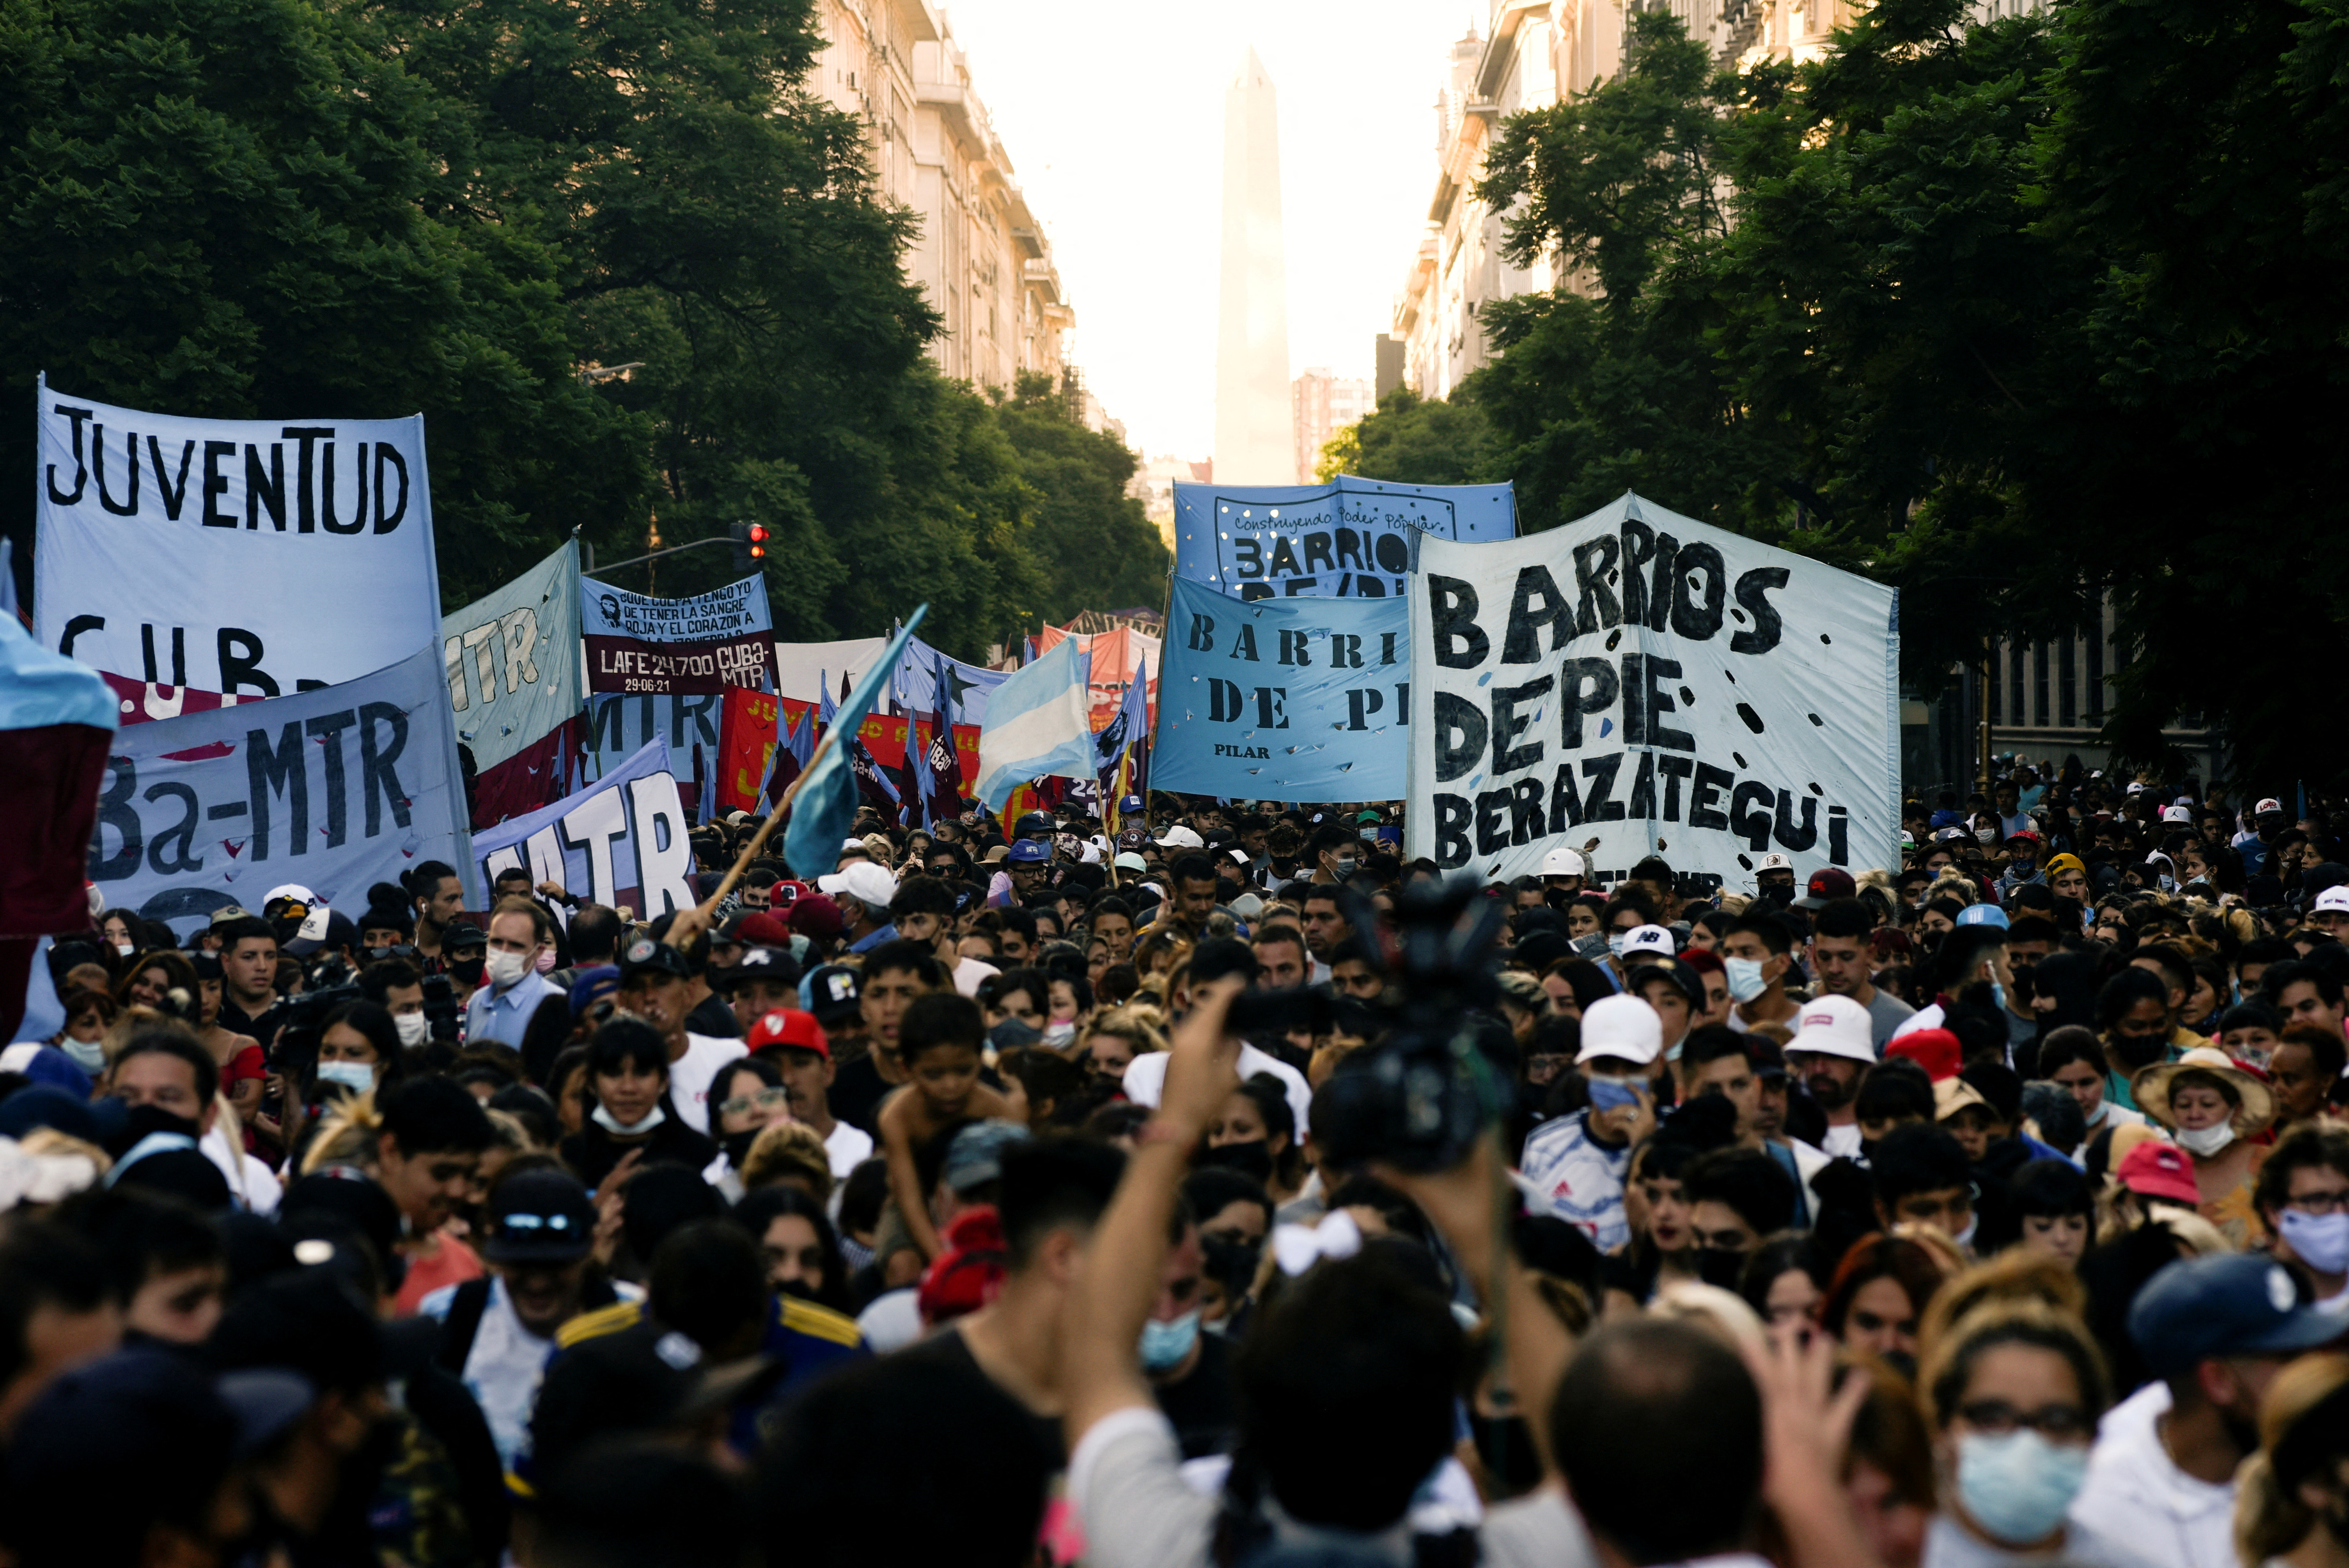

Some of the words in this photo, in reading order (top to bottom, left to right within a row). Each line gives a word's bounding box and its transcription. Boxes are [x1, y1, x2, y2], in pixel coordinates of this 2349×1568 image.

[47, 404, 408, 535] JUVENTUD
[1235, 513, 1331, 534] Construyendo
[1339, 507, 1378, 524] Poder
[736, 581, 750, 596] YO
[1427, 518, 1790, 669] BARRIOS
[624, 606, 637, 618] DE
[640, 608, 679, 620] TENER
[682, 606, 698, 619] LA
[700, 597, 746, 617] SANGRE
[626, 620, 656, 634] ROJA
[657, 622, 667, 634] Y
[670, 622, 685, 634] EL
[687, 614, 741, 634] CORAZON
[745, 612, 754, 625] A
[1188, 613, 1397, 669] BARRI
[652, 655, 714, 676] 24.700
[721, 664, 764, 688] MTR
[625, 679, 669, 691] 29-06-21
[1208, 677, 1289, 729] DE
[747, 699, 883, 738] JUVUD
[1435, 673, 1553, 783] DE
[1561, 653, 1695, 752] PIE
[1214, 743, 1270, 759] PILAR
